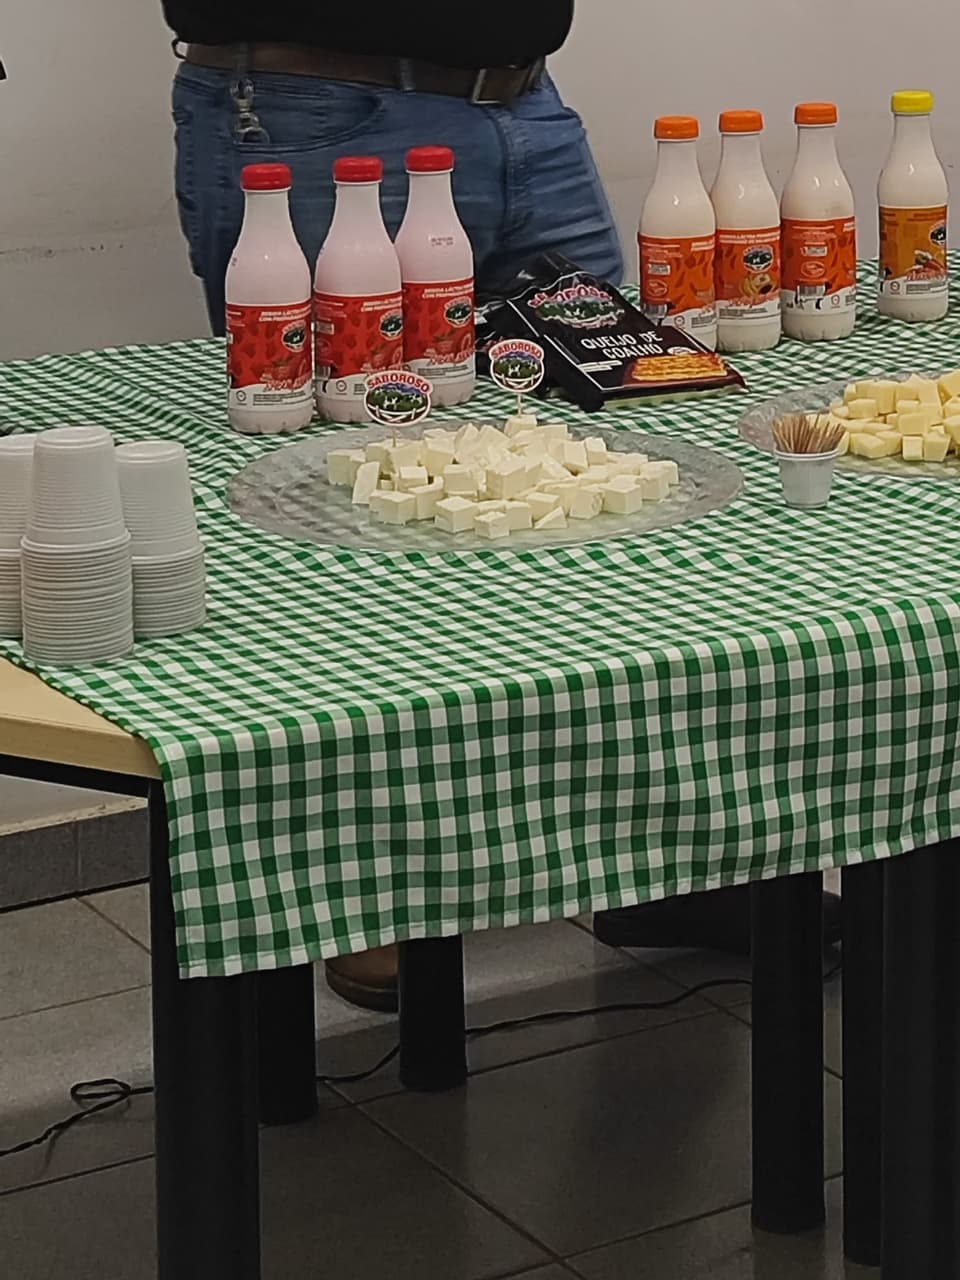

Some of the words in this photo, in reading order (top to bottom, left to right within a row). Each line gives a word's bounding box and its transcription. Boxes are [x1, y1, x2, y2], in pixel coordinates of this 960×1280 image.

[580, 334, 636, 349] QUEIJO
[639, 330, 663, 343] DE
[493, 342, 541, 359] SABOROSO
[602, 344, 663, 359] COALHO
[367, 372, 430, 393] SABOROSO
